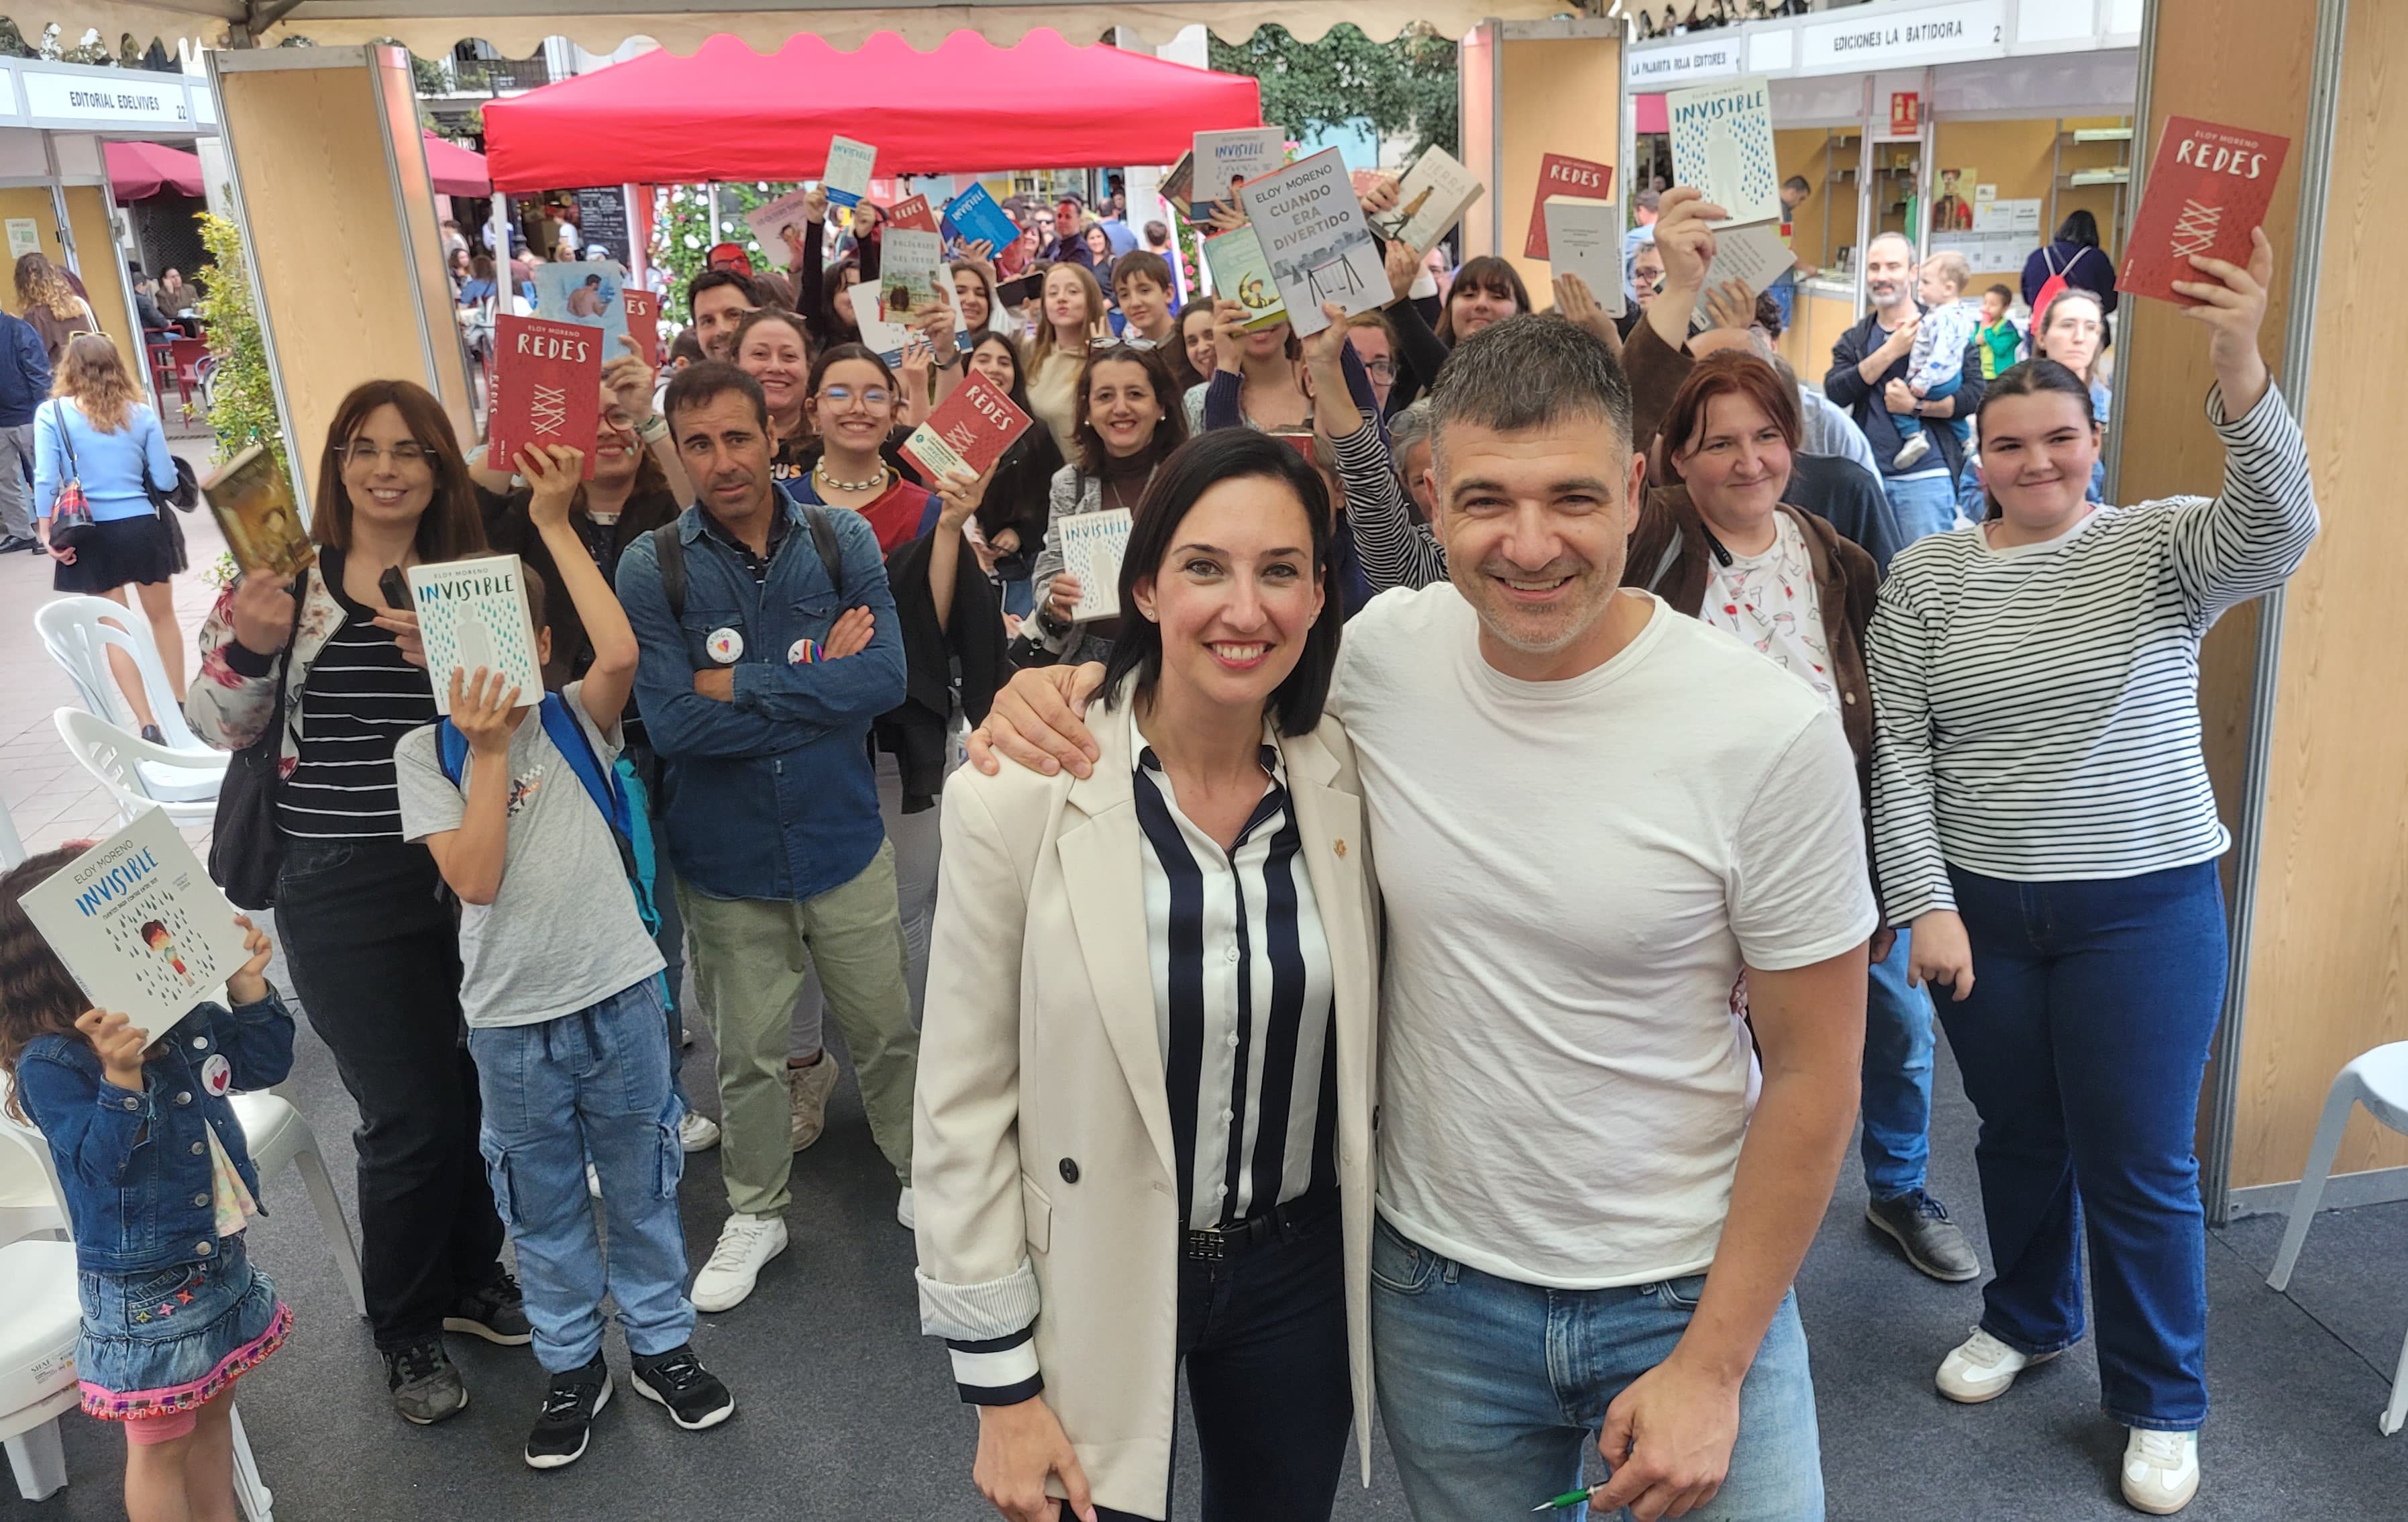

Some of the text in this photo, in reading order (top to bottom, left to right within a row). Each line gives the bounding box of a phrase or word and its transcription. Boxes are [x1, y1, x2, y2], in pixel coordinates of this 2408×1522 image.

[1834, 20, 2001, 52] EDICIONES LA BATIDORA 2
[1631, 64, 1640, 76] LA
[1641, 59, 1671, 74] PAJARITA
[1674, 58, 1691, 70] ROJA
[1693, 52, 1726, 67] EDITORES
[70, 91, 187, 119] EDITORIAL EDELVIVES 22
[1675, 90, 1765, 123] INVISIBLE
[1215, 142, 1265, 159] INVISIBLE
[2195, 130, 2259, 149] ELOY MORENO
[2176, 139, 2268, 179] REDES
[1255, 185, 1281, 203] ELOY
[1286, 164, 1332, 191] MORENO
[1550, 164, 1601, 188] REDES
[1270, 185, 1330, 217] CUANDO
[1292, 206, 1321, 225] ERA
[1273, 211, 1350, 251] DIVERTIDO
[527, 325, 580, 338] ELOY MORENO
[517, 334, 590, 363] REDES
[490, 374, 500, 415] REDES
[965, 385, 1014, 431] REDES
[456, 568, 489, 576] MORENO
[418, 574, 515, 605] INVISIBLE
[74, 840, 134, 884] ELOY MORENO
[74, 846, 159, 917] INVISIBLE
